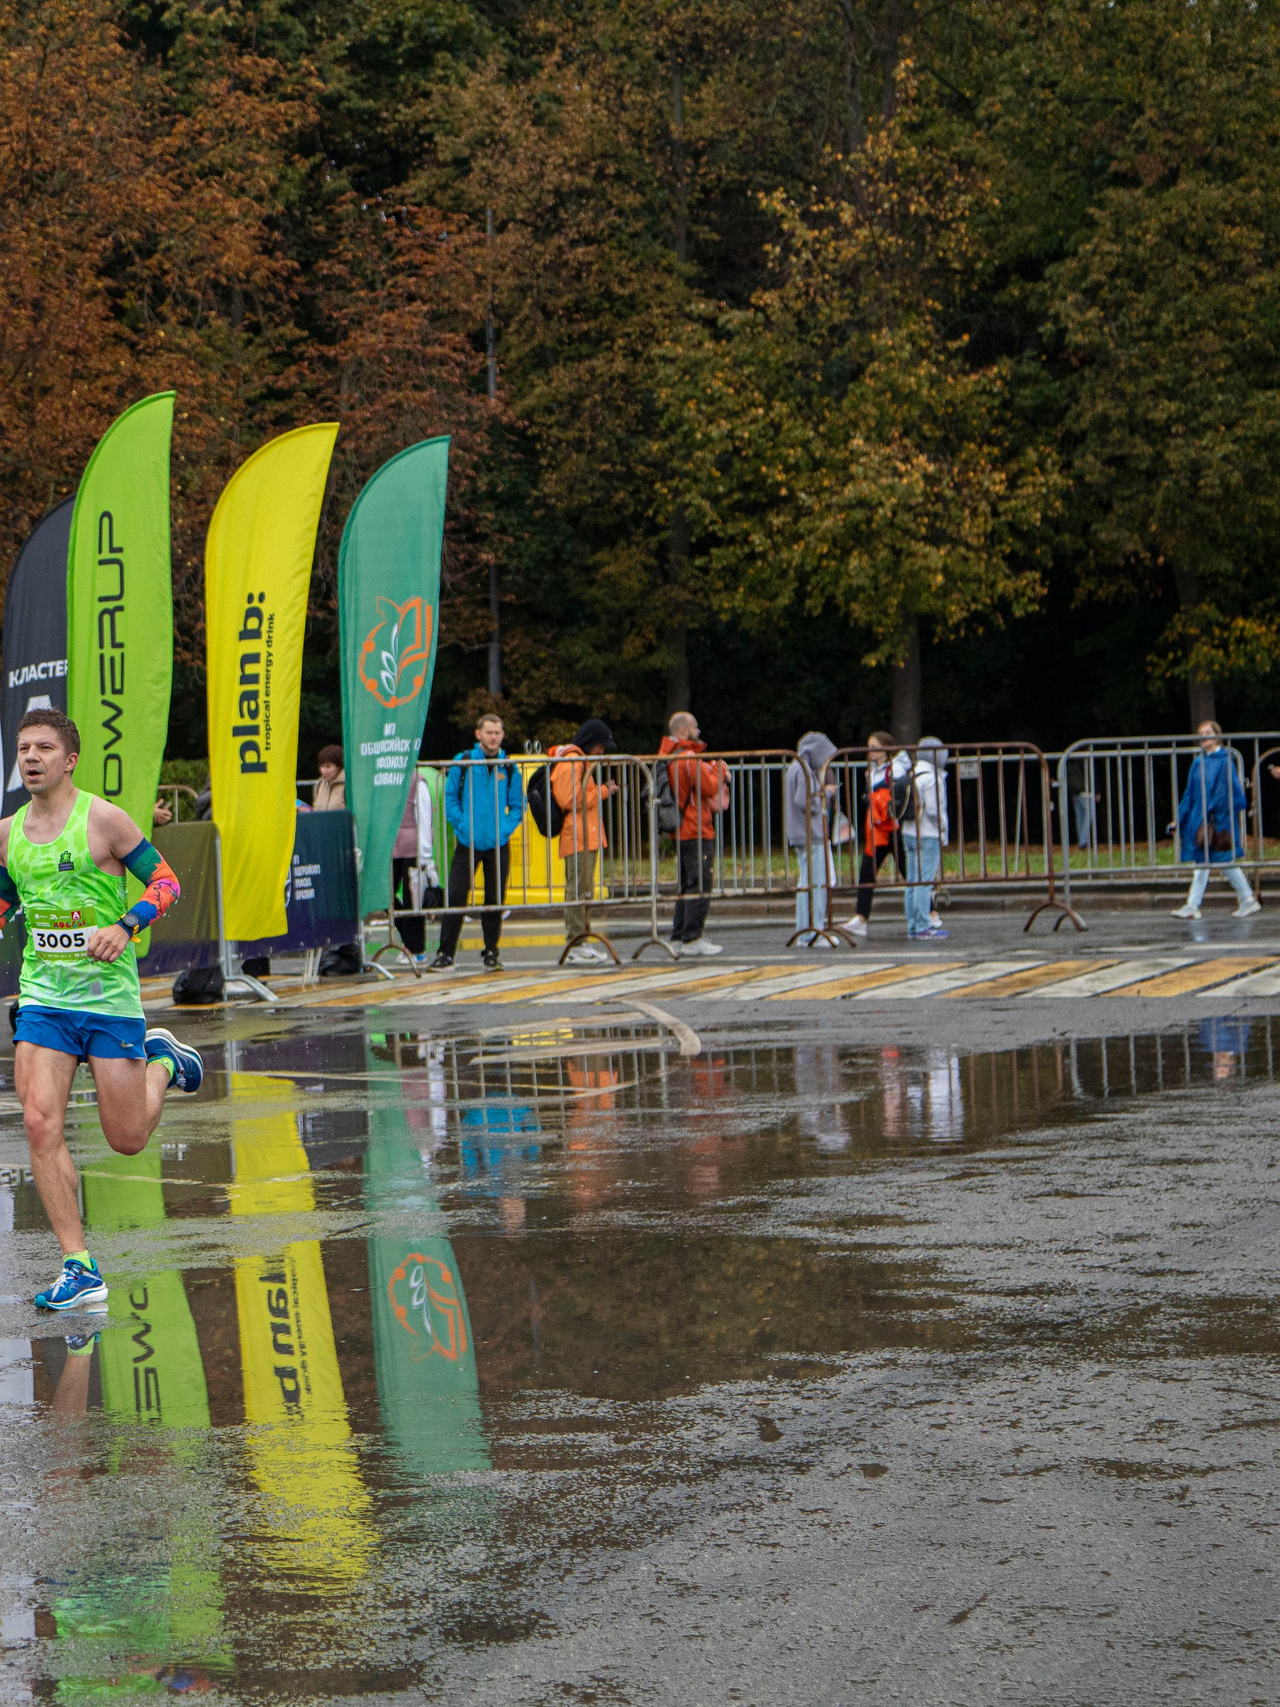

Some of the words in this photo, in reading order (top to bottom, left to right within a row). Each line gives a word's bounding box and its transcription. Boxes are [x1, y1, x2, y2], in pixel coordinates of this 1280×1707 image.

[238, 591, 266, 642] b:
[265, 613, 275, 648] drink
[97, 510, 125, 803] OWERUP
[264, 650, 274, 697] energy
[231, 652, 268, 774] plan
[263, 700, 273, 751] tropical
[36, 932, 86, 948] 3005
